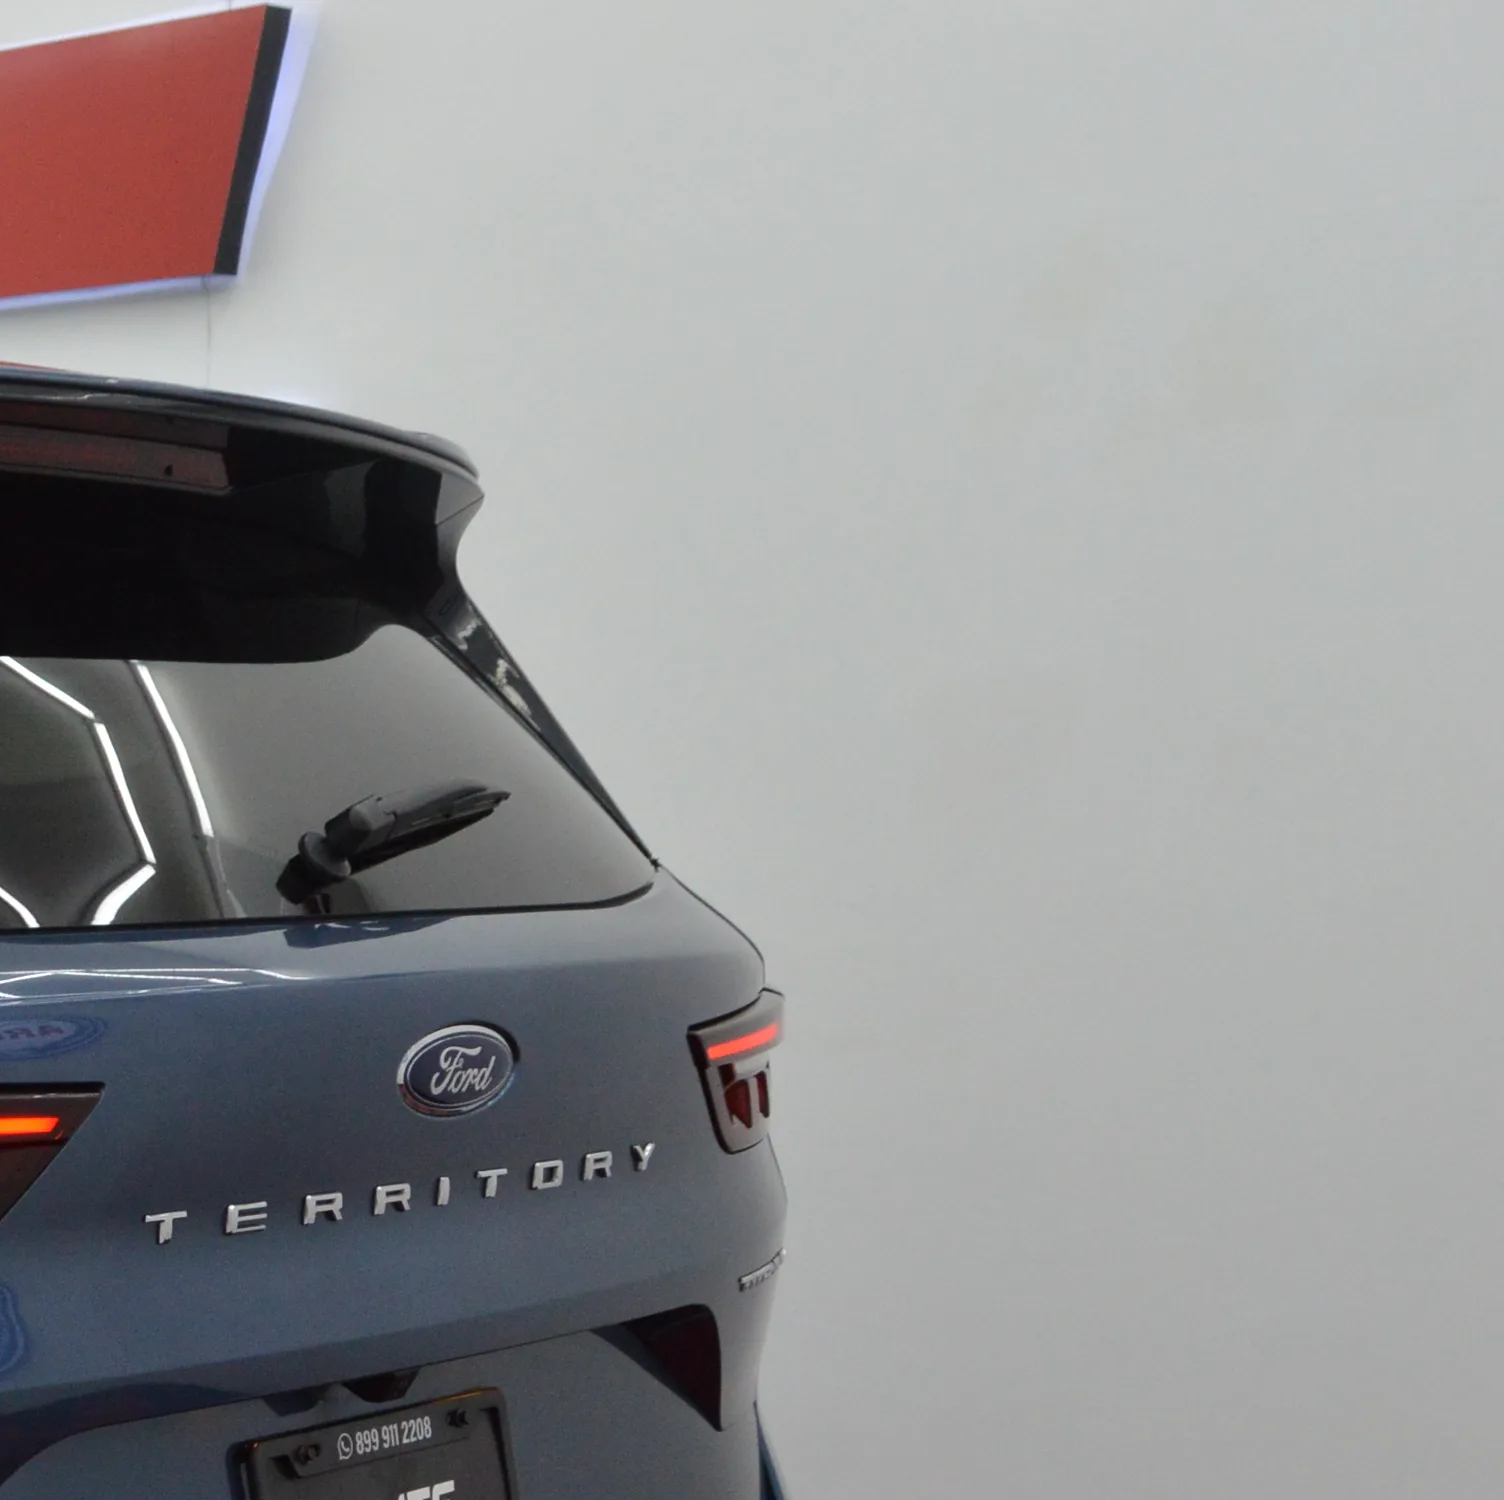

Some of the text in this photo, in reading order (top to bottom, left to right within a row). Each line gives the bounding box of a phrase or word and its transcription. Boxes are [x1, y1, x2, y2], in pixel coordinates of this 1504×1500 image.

[428, 1044, 497, 1096] Ford
[144, 1141, 656, 1246] TERRITORY
[355, 1415, 433, 1455] 899 911 2208
